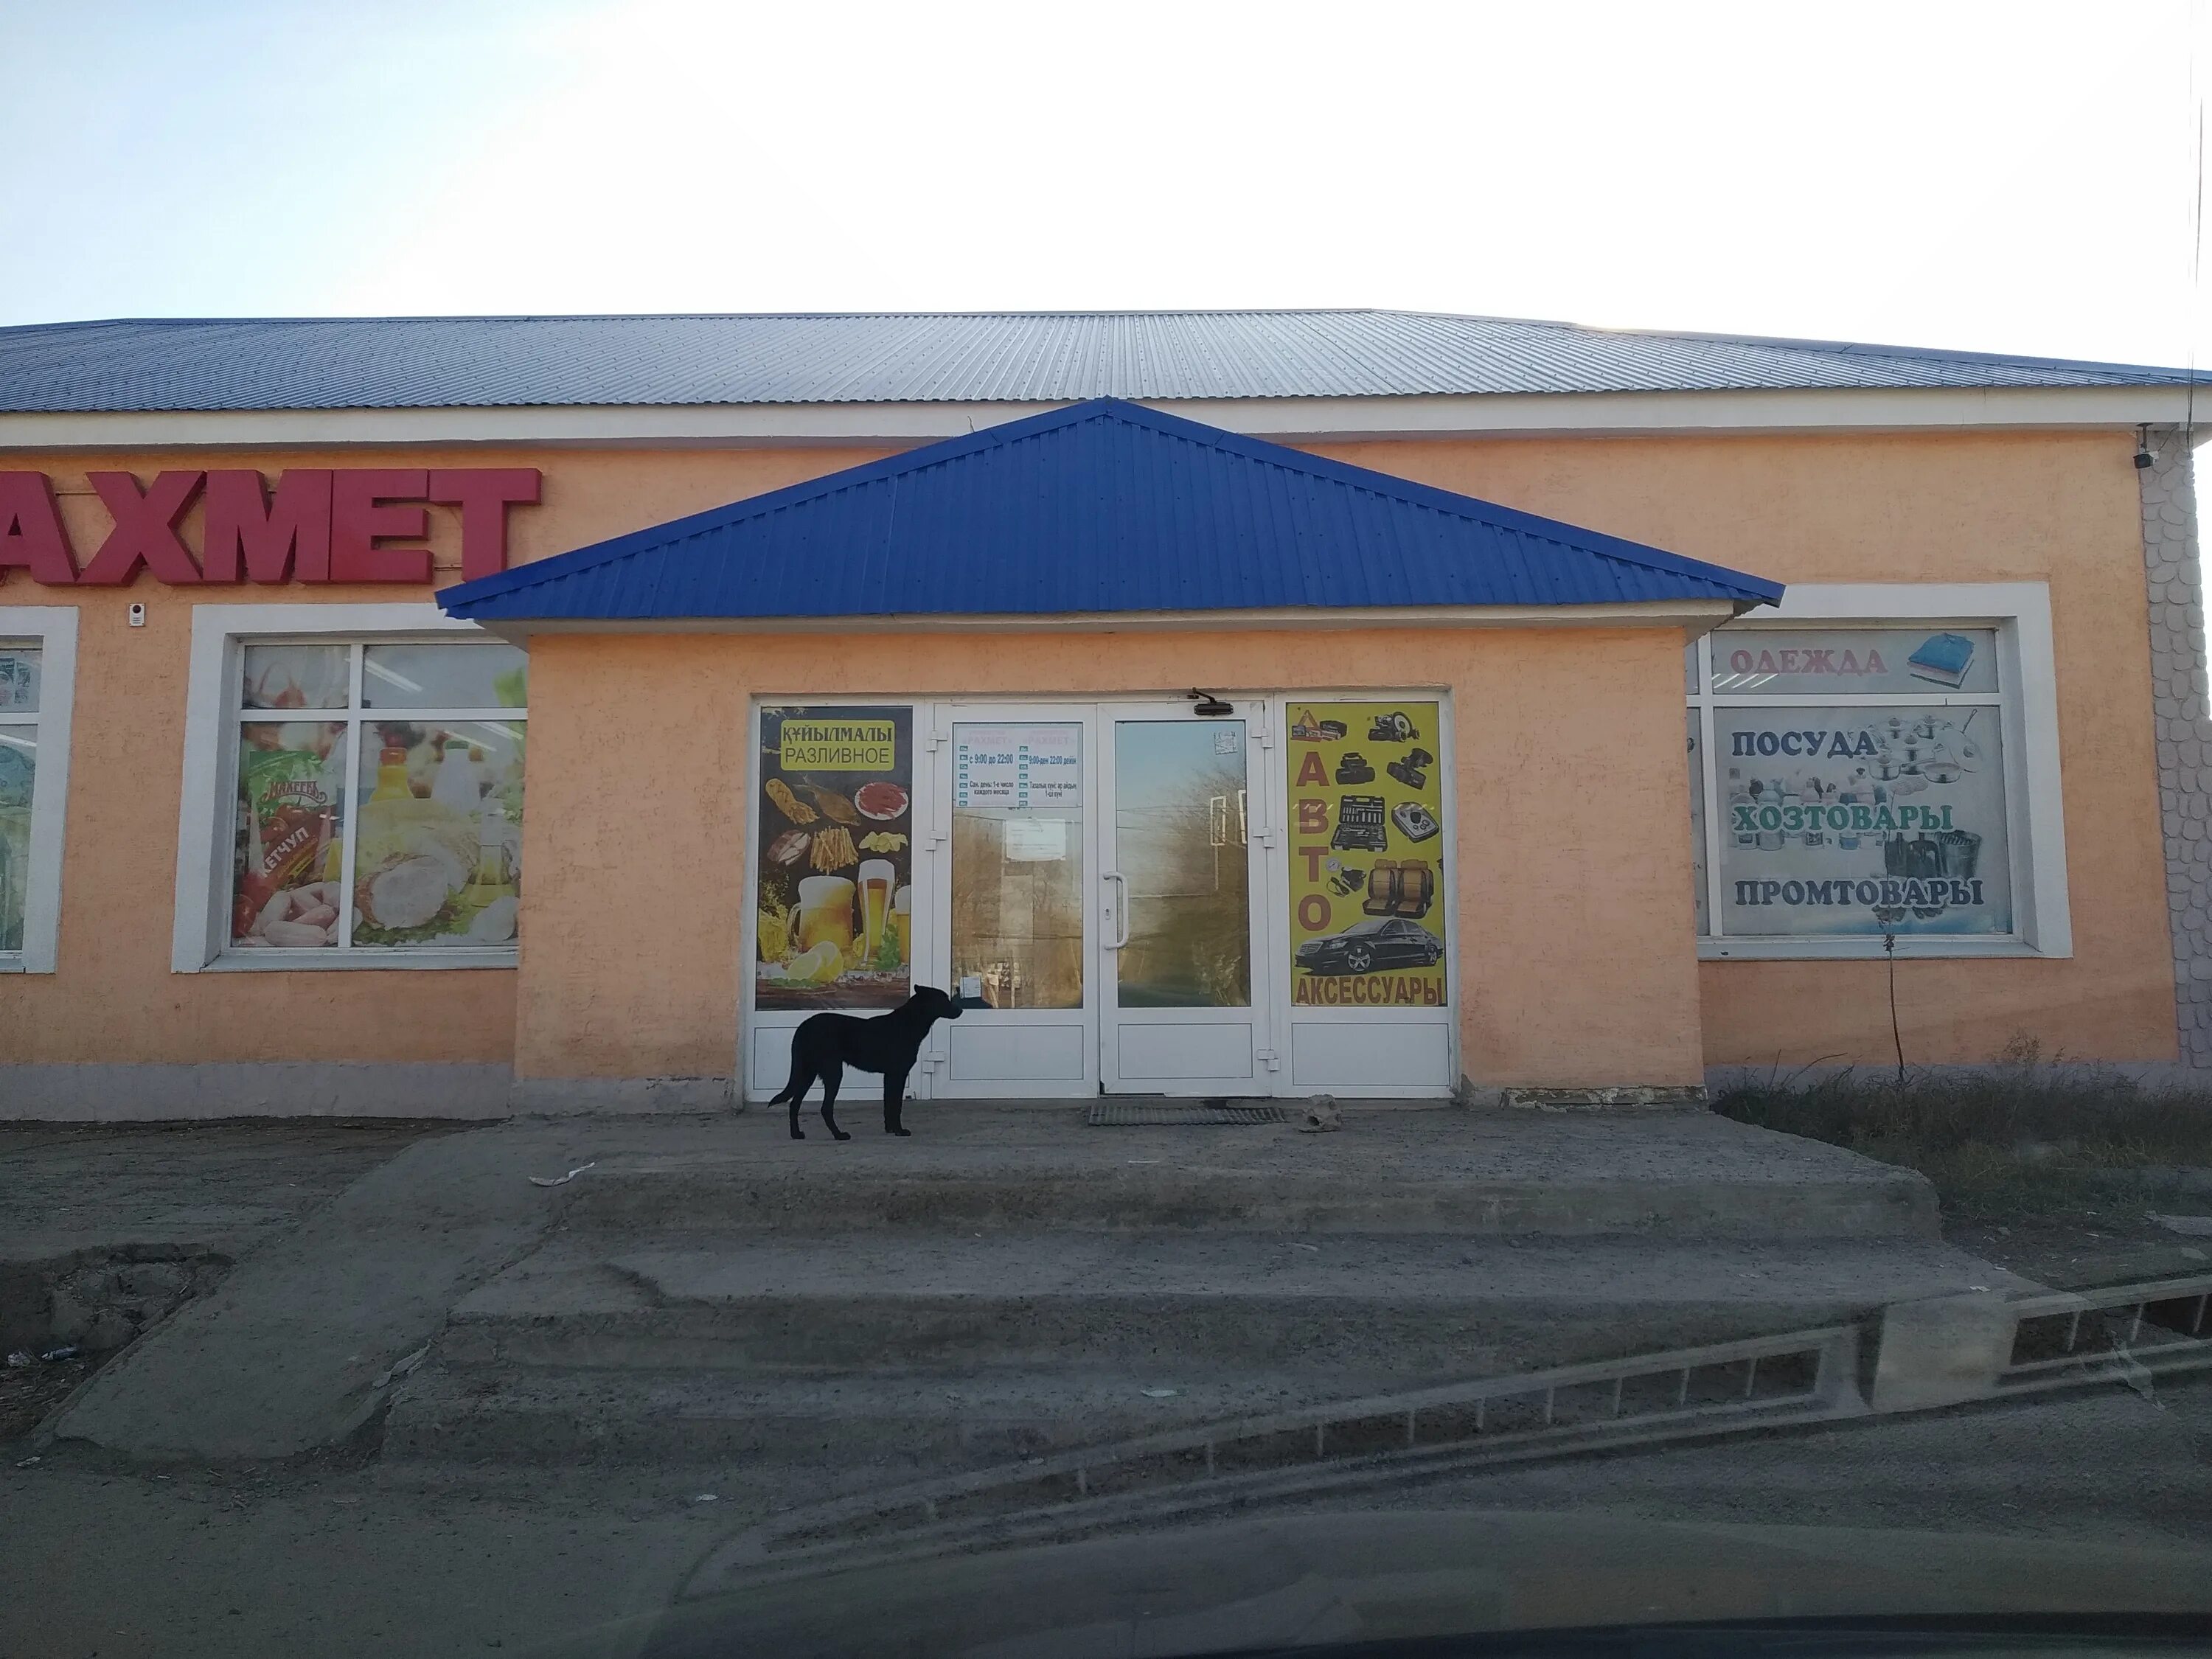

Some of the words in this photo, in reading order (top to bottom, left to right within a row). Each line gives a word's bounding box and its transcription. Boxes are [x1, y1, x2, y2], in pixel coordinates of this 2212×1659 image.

[1730, 649, 1888, 676] ОДЕЖДА
[783, 725, 892, 745] ҚҰЙЫЛМАЛЫ
[1731, 731, 1879, 759] ПОСУДА
[785, 748, 889, 764] РАЗЛИВНОЕ
[975, 754, 987, 764] 9:00
[989, 757, 996, 766] до
[998, 754, 1013, 764] 22:00
[1050, 755, 1062, 765] 22:00
[1734, 805, 1953, 830] ХОЗТОВАРЫ
[1296, 751, 1332, 932] АВТО
[1735, 880, 1984, 905] ПРОМТОВАРЫ
[1295, 975, 1443, 1005] АКСЕССУАРЫ
